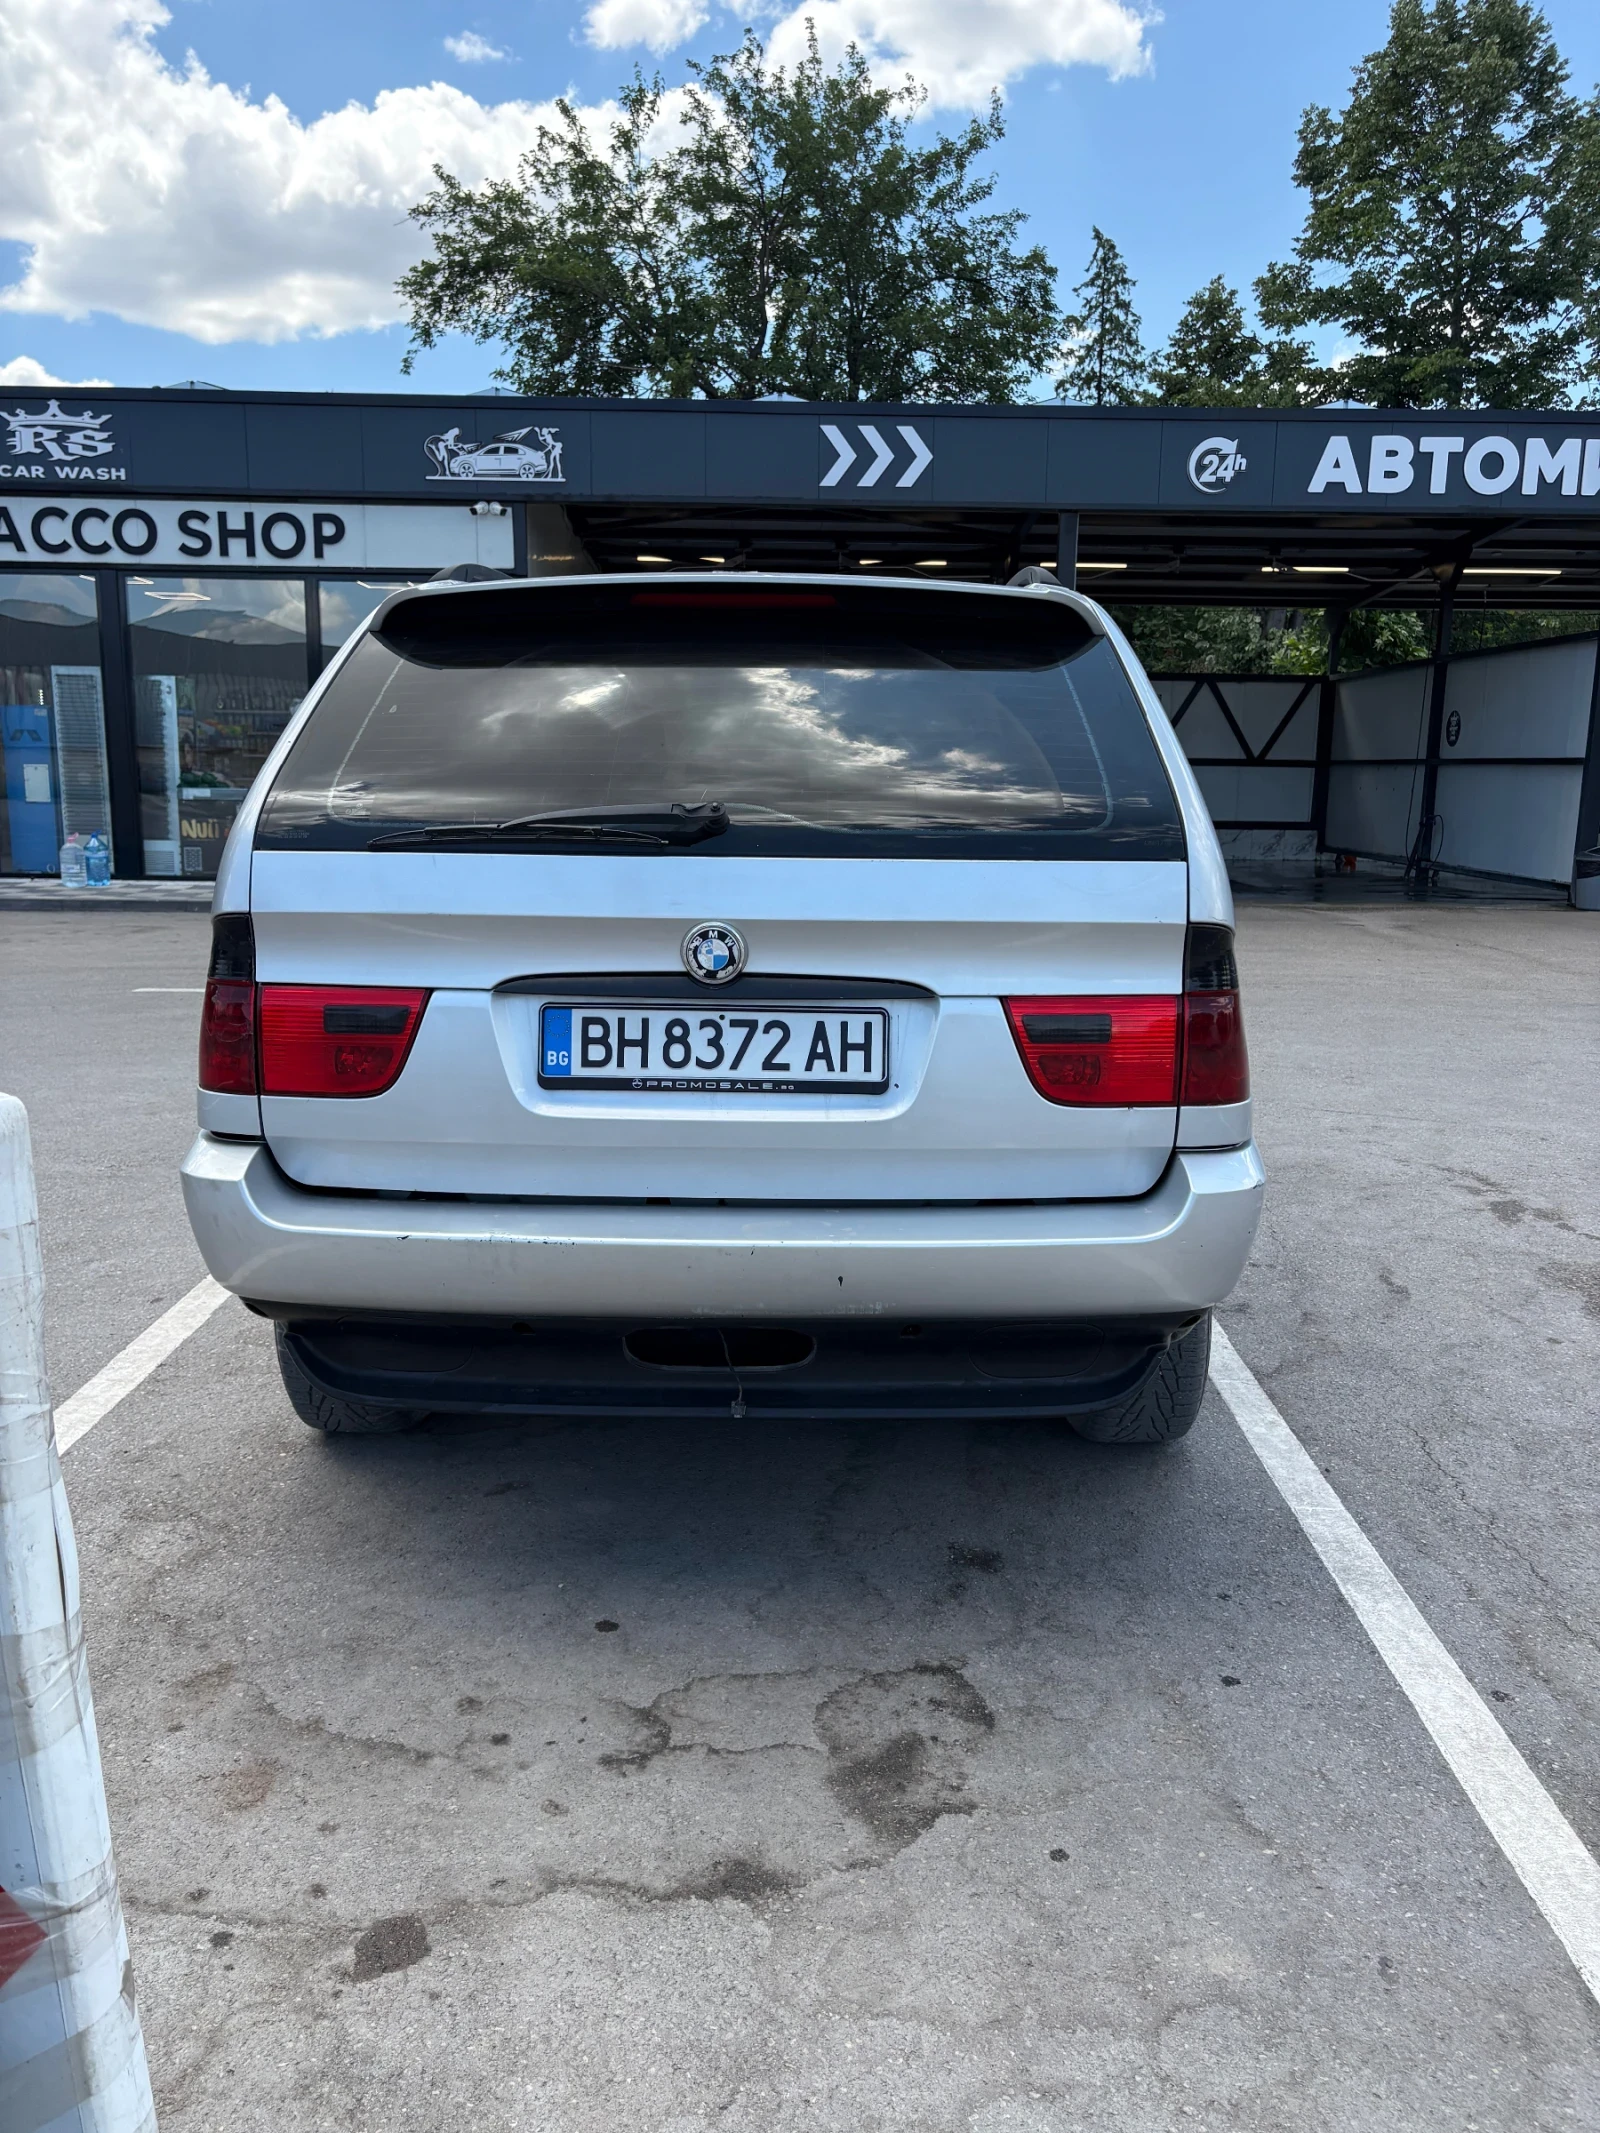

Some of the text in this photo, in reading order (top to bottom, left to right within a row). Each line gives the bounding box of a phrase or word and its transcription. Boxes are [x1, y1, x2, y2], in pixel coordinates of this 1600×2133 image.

[6, 425, 116, 461] RS
[0, 464, 126, 481] CAR WASH
[1199, 453, 1247, 483] 24h
[177, 509, 346, 559] SHOP
[547, 1050, 569, 1067] BG
[580, 1016, 872, 1073] BH 8372 AH
